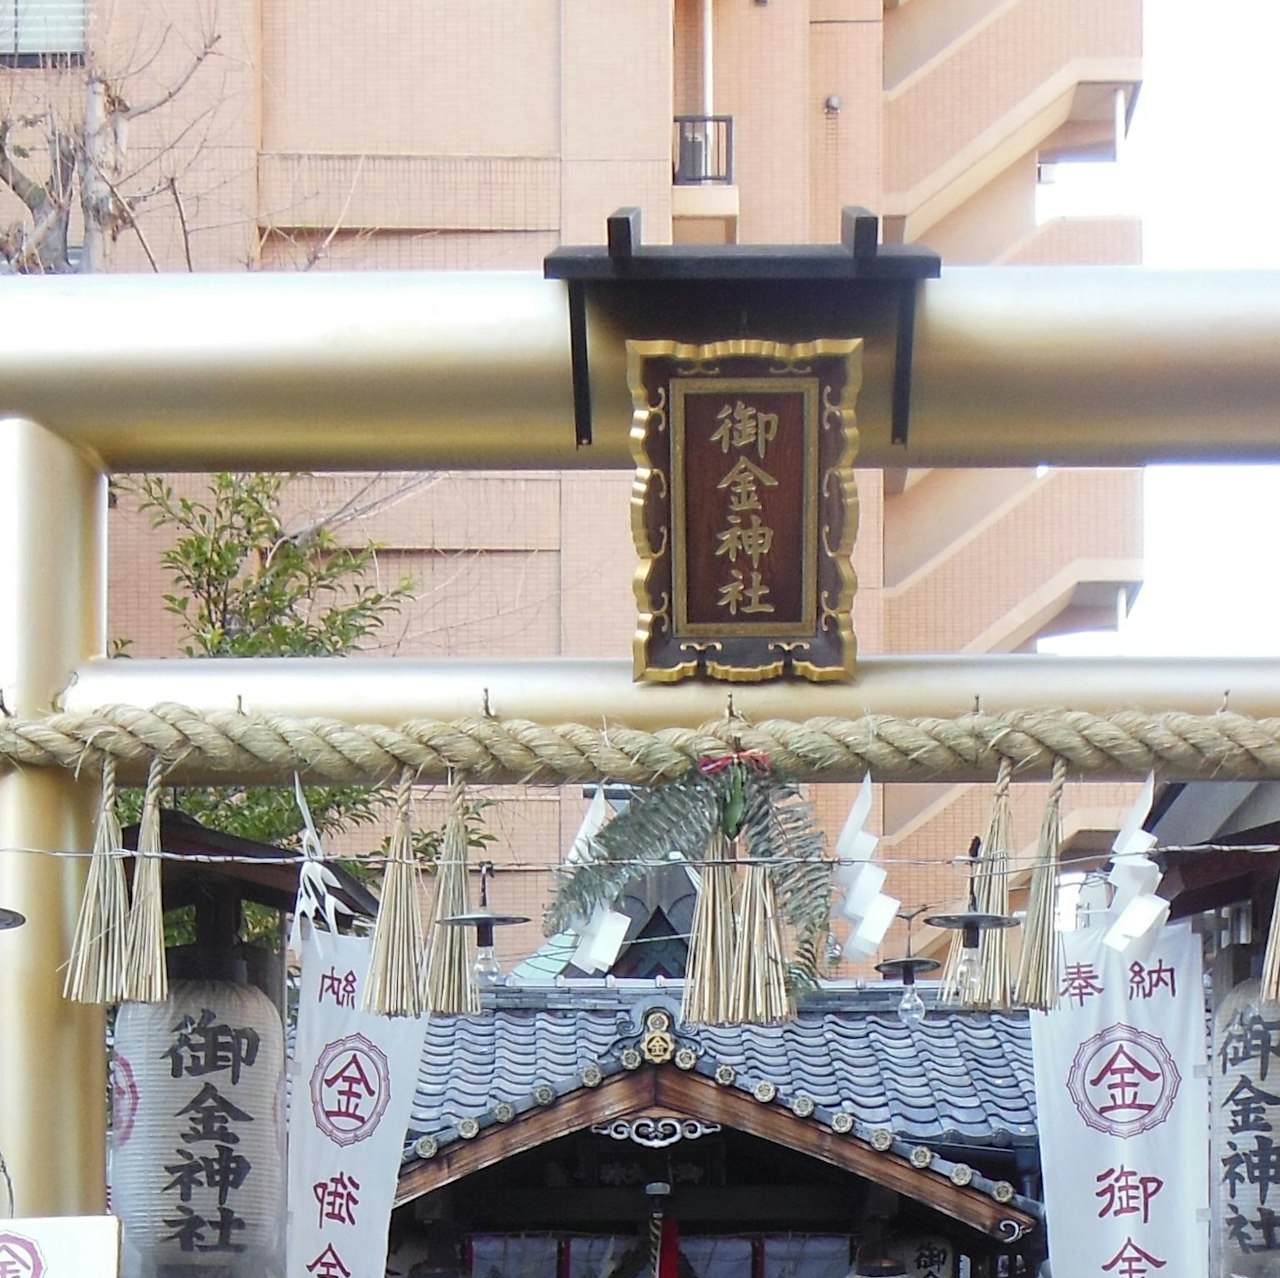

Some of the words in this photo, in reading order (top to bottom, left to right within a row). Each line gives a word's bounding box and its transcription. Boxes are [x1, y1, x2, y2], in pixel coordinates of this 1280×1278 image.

[710, 400, 780, 615] 御金神社
[1060, 960, 1177, 1001] 奉納
[160, 1008, 261, 1254] 御金神社
[1089, 1043, 1161, 1116] 金
